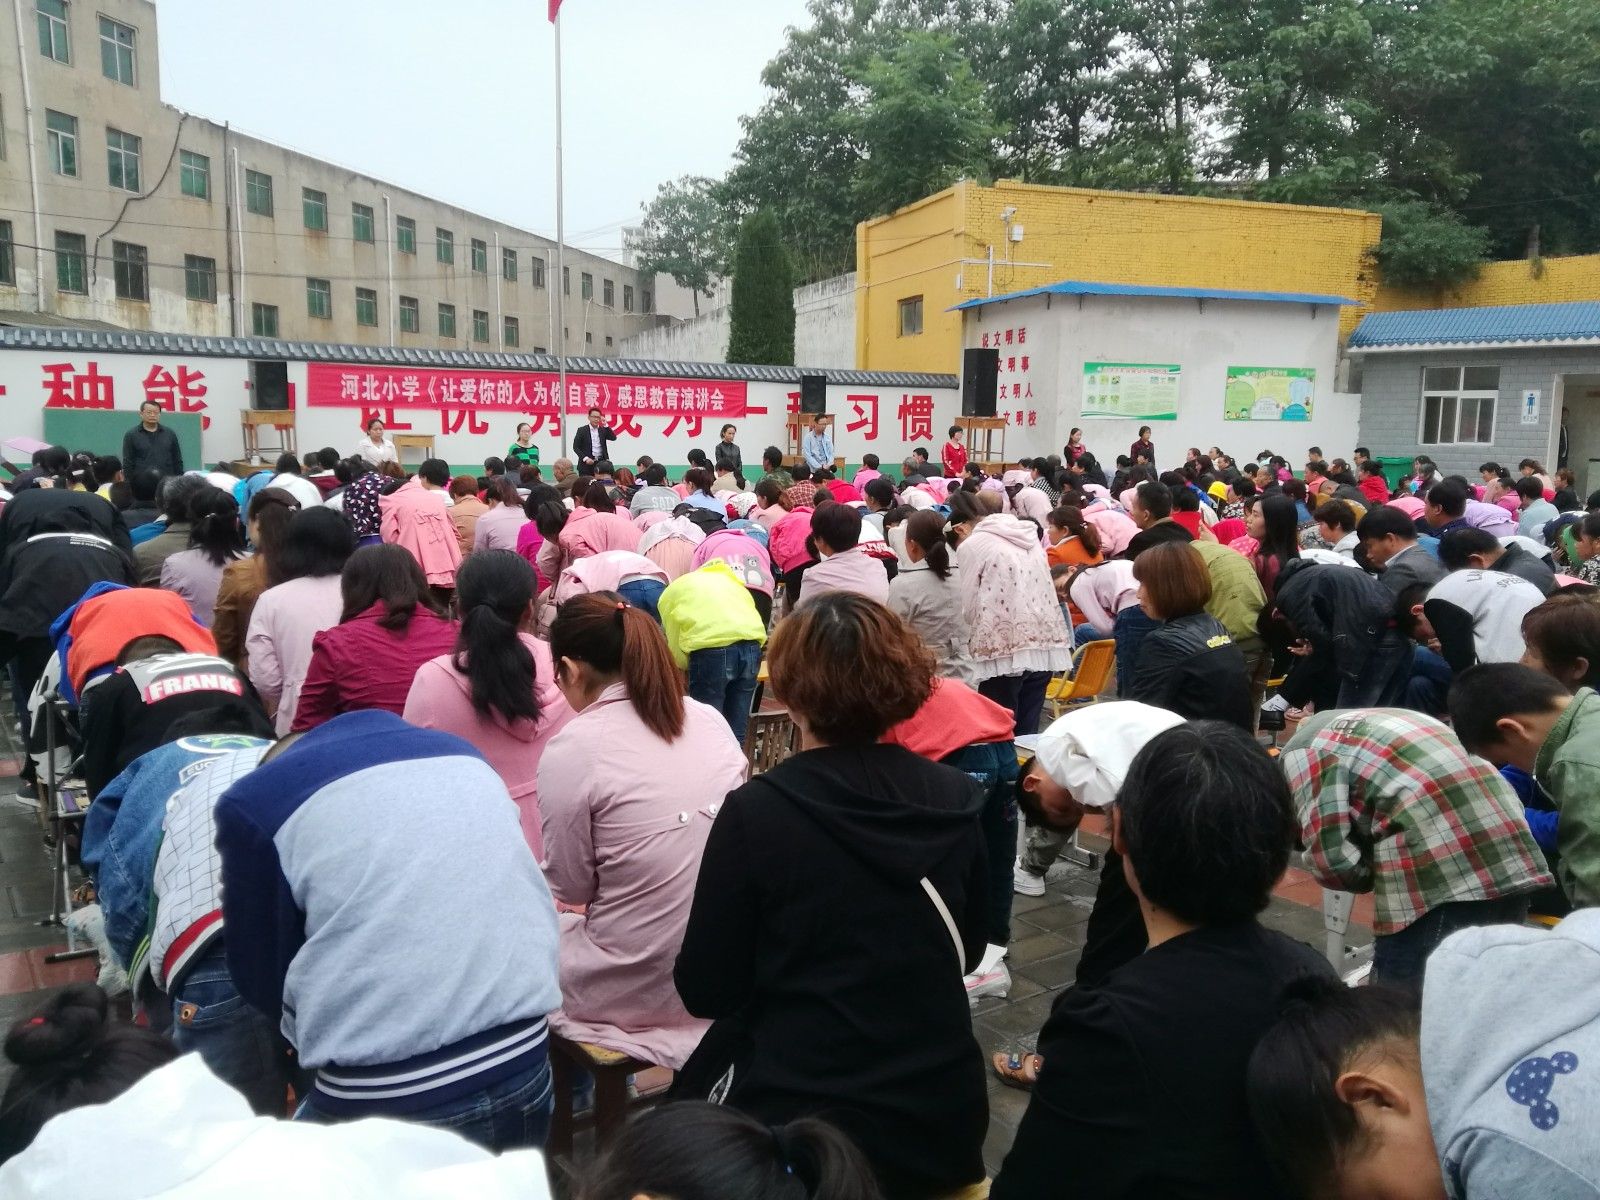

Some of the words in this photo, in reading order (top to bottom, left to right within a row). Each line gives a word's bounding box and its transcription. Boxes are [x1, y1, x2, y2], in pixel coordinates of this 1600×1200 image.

[981, 327, 1026, 348] 说文明话
[340, 372, 725, 411] 河北小学《让爱你的人为你自豪》感恩教育演讲会
[995, 409, 1037, 426] 文明校
[148, 673, 237, 701] FRANK
